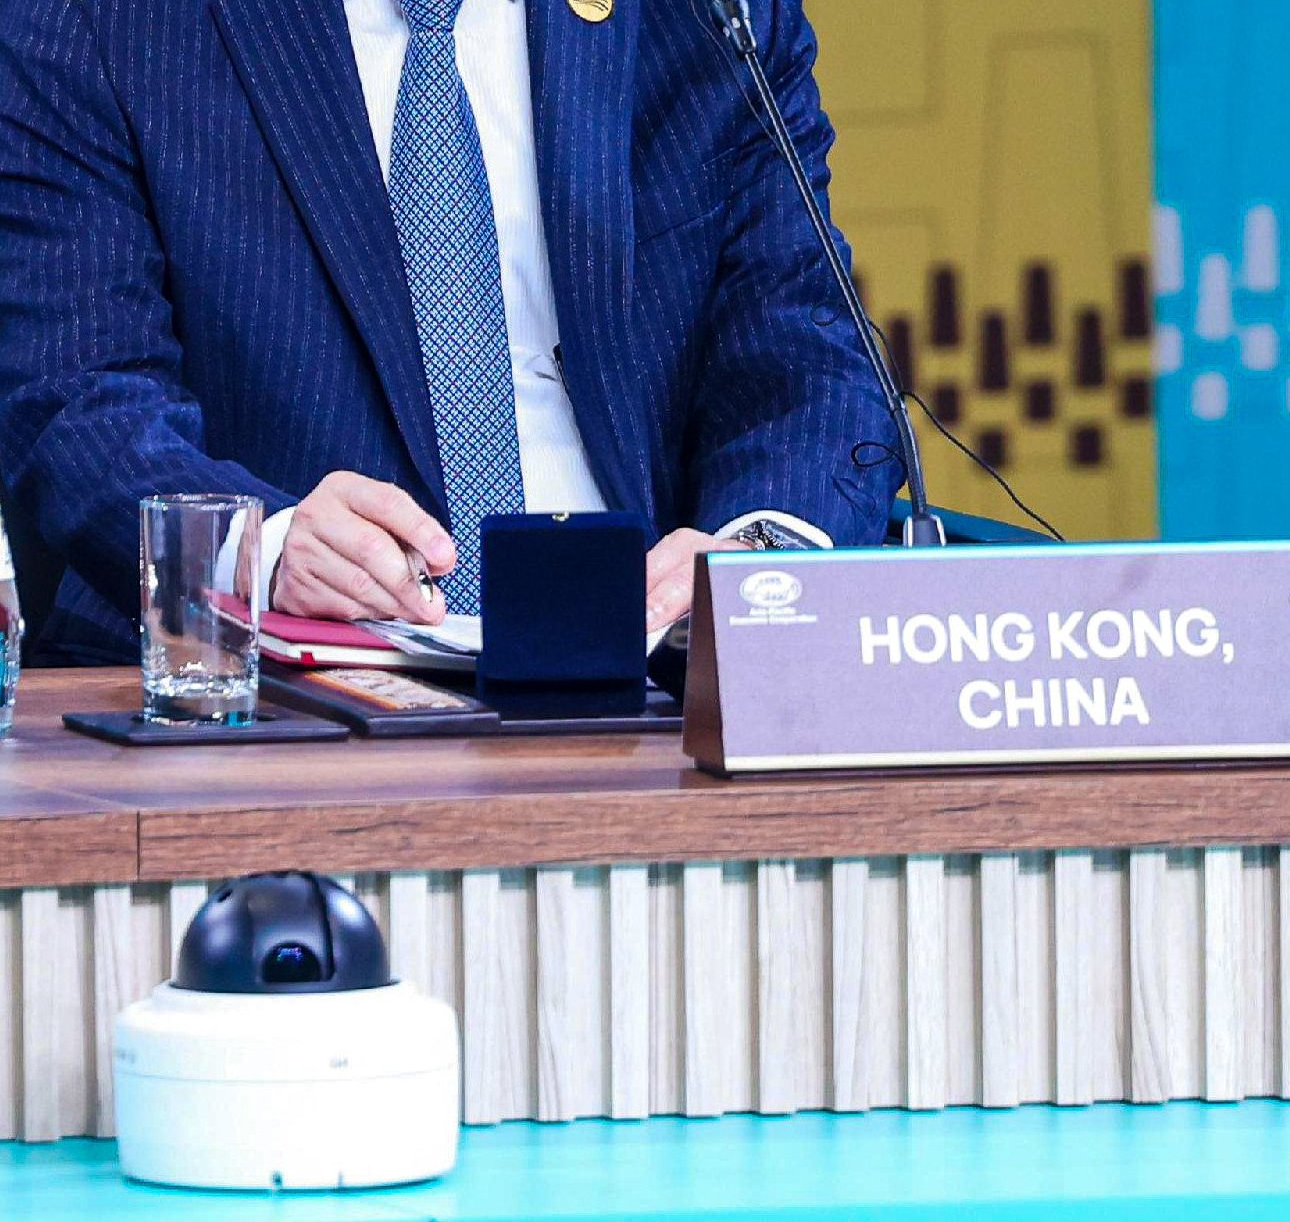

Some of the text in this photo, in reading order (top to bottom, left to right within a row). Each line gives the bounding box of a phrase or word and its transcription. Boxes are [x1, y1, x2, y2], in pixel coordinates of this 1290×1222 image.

[859, 606, 1235, 665] HONG KONG,
[957, 676, 1151, 730] CHINA
